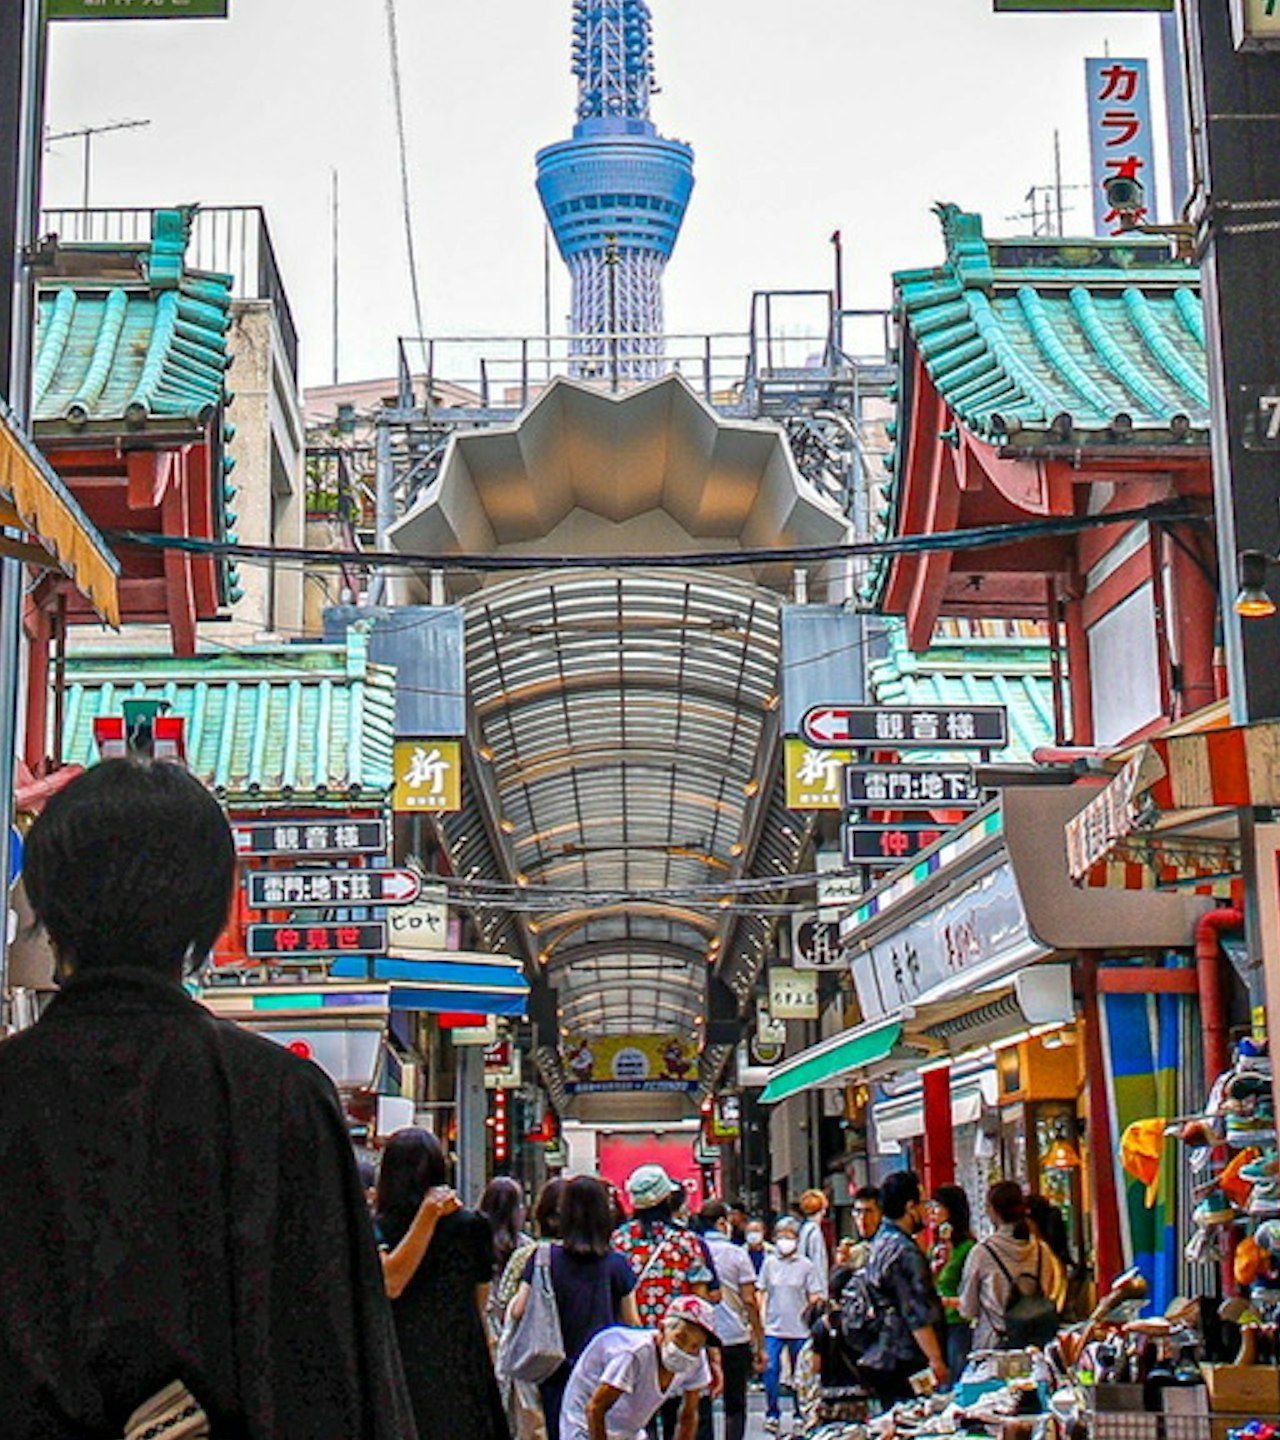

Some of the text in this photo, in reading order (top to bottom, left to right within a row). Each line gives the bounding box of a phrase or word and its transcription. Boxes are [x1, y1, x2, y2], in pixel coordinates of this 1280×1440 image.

[875, 712, 976, 739] 観音様
[402, 746, 451, 796] 新
[273, 825, 360, 850] 観音様
[274, 927, 362, 951] 仲見世
